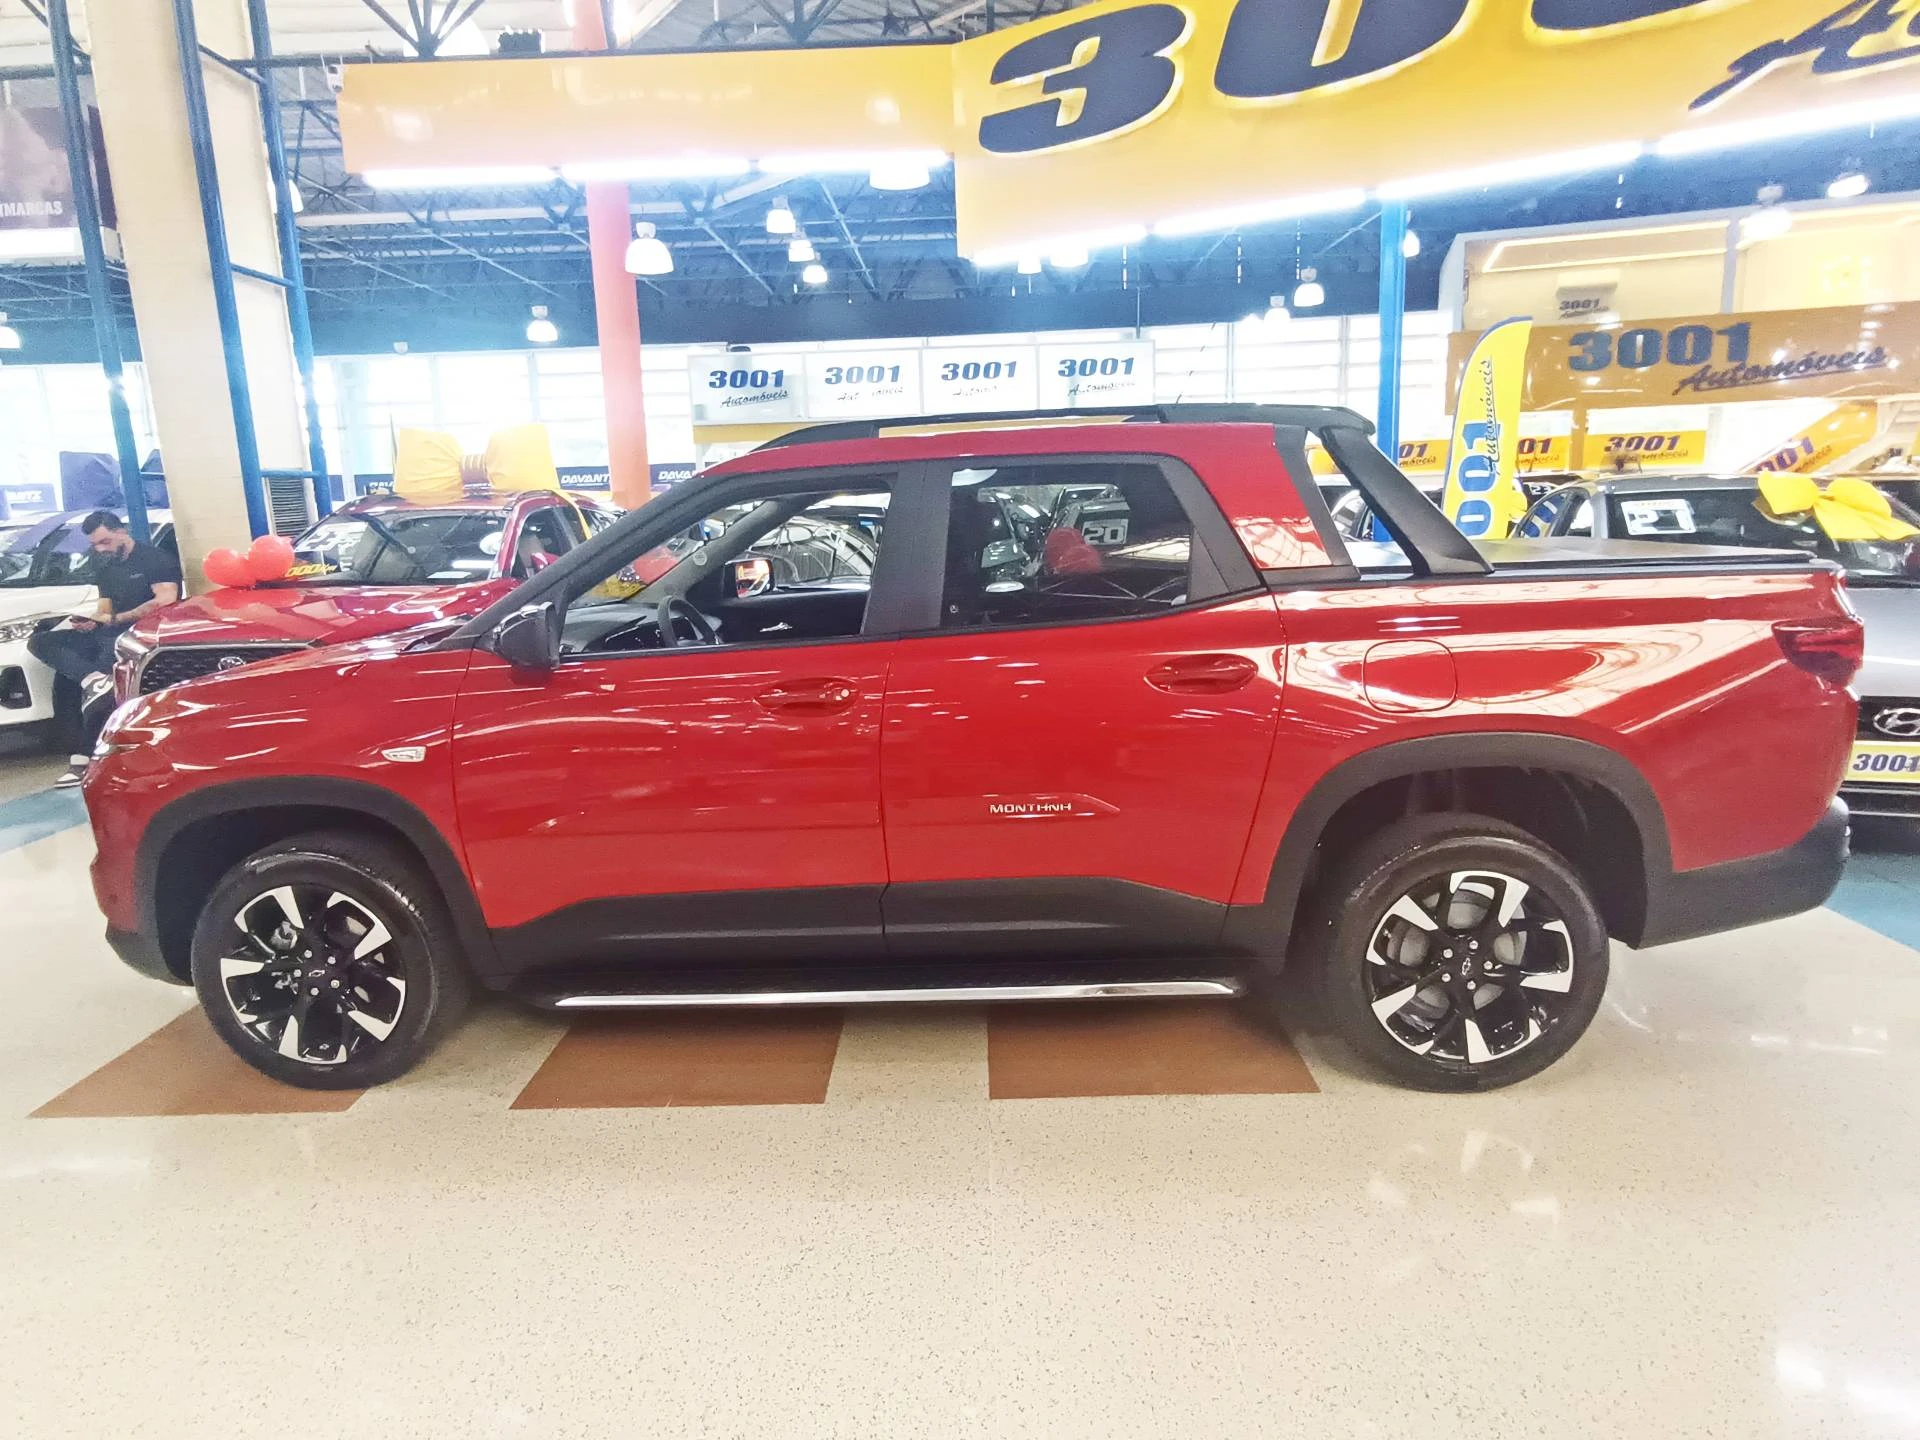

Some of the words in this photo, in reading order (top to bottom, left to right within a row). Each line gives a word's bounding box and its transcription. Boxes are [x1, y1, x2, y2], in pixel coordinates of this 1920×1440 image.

[1568, 321, 1752, 371] 3001
[824, 365, 901, 385] 3001
[941, 361, 1017, 381] 3001
[1058, 357, 1135, 378] 3001
[1671, 346, 1888, 396] Automóveis
[708, 369, 784, 389] 3001
[720, 389, 790, 408] Automóveis
[1604, 435, 1680, 452] 3001
